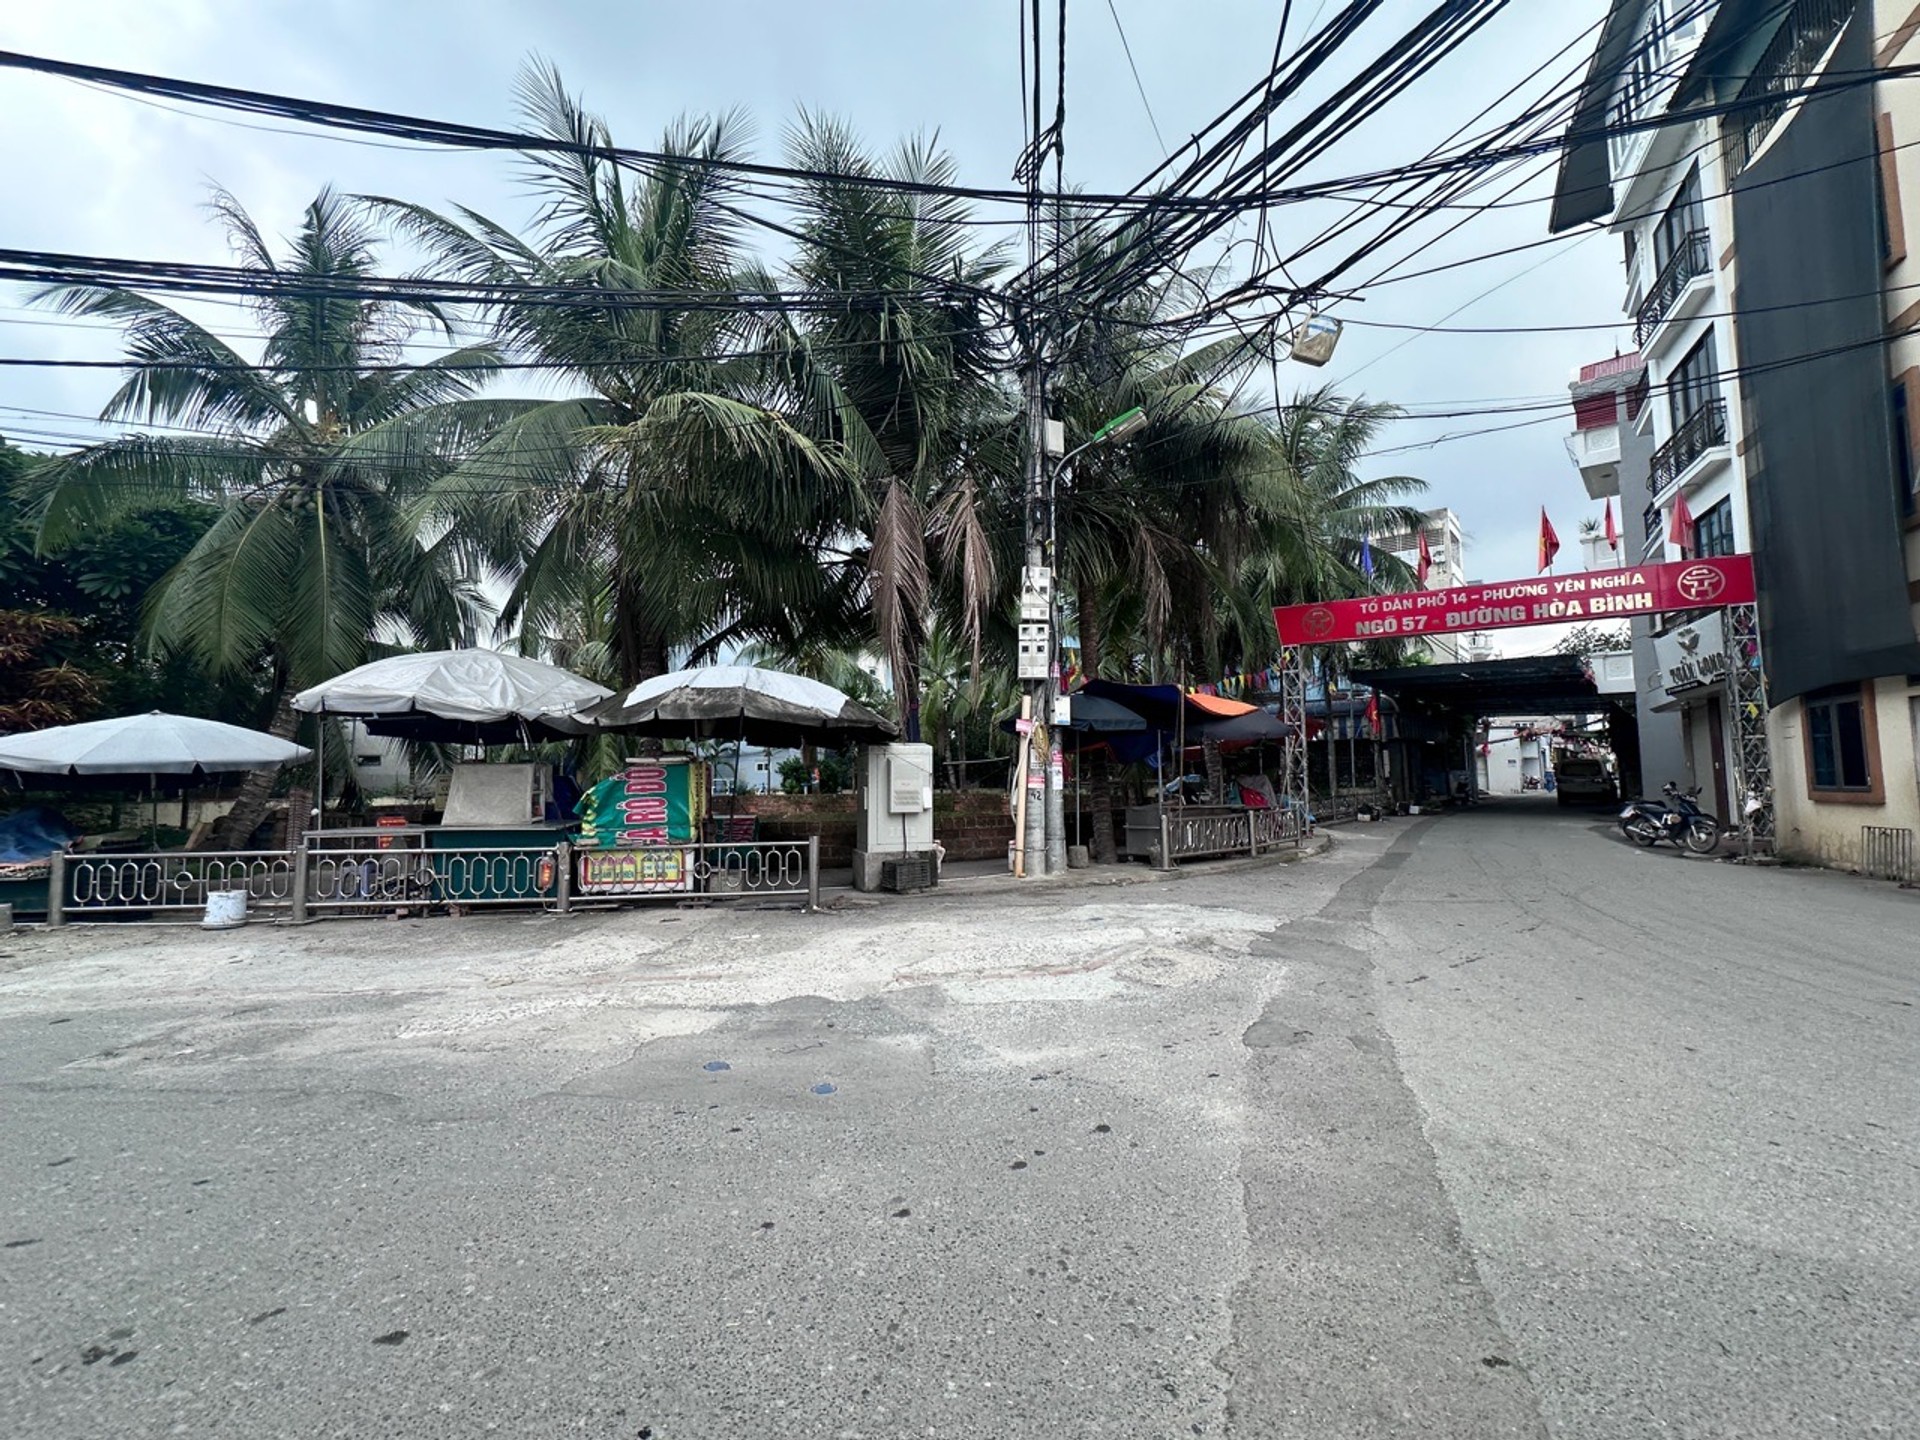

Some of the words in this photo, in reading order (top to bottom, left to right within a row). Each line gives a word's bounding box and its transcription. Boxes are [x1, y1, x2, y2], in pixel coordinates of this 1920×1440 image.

[1382, 597, 1413, 612] DÂN
[1417, 591, 1448, 608] PHỐ
[1451, 592, 1467, 605] 14
[1482, 583, 1548, 601] PHƯỜNG
[1553, 578, 1585, 594] YÊN
[1590, 572, 1645, 590] NGHĨA
[1355, 615, 1397, 635] NGÕ
[1402, 615, 1427, 632] 57
[1445, 605, 1526, 628] ĐƯỜNG
[1533, 598, 1584, 619] HÒA
[1589, 592, 1653, 614] BÌNH
